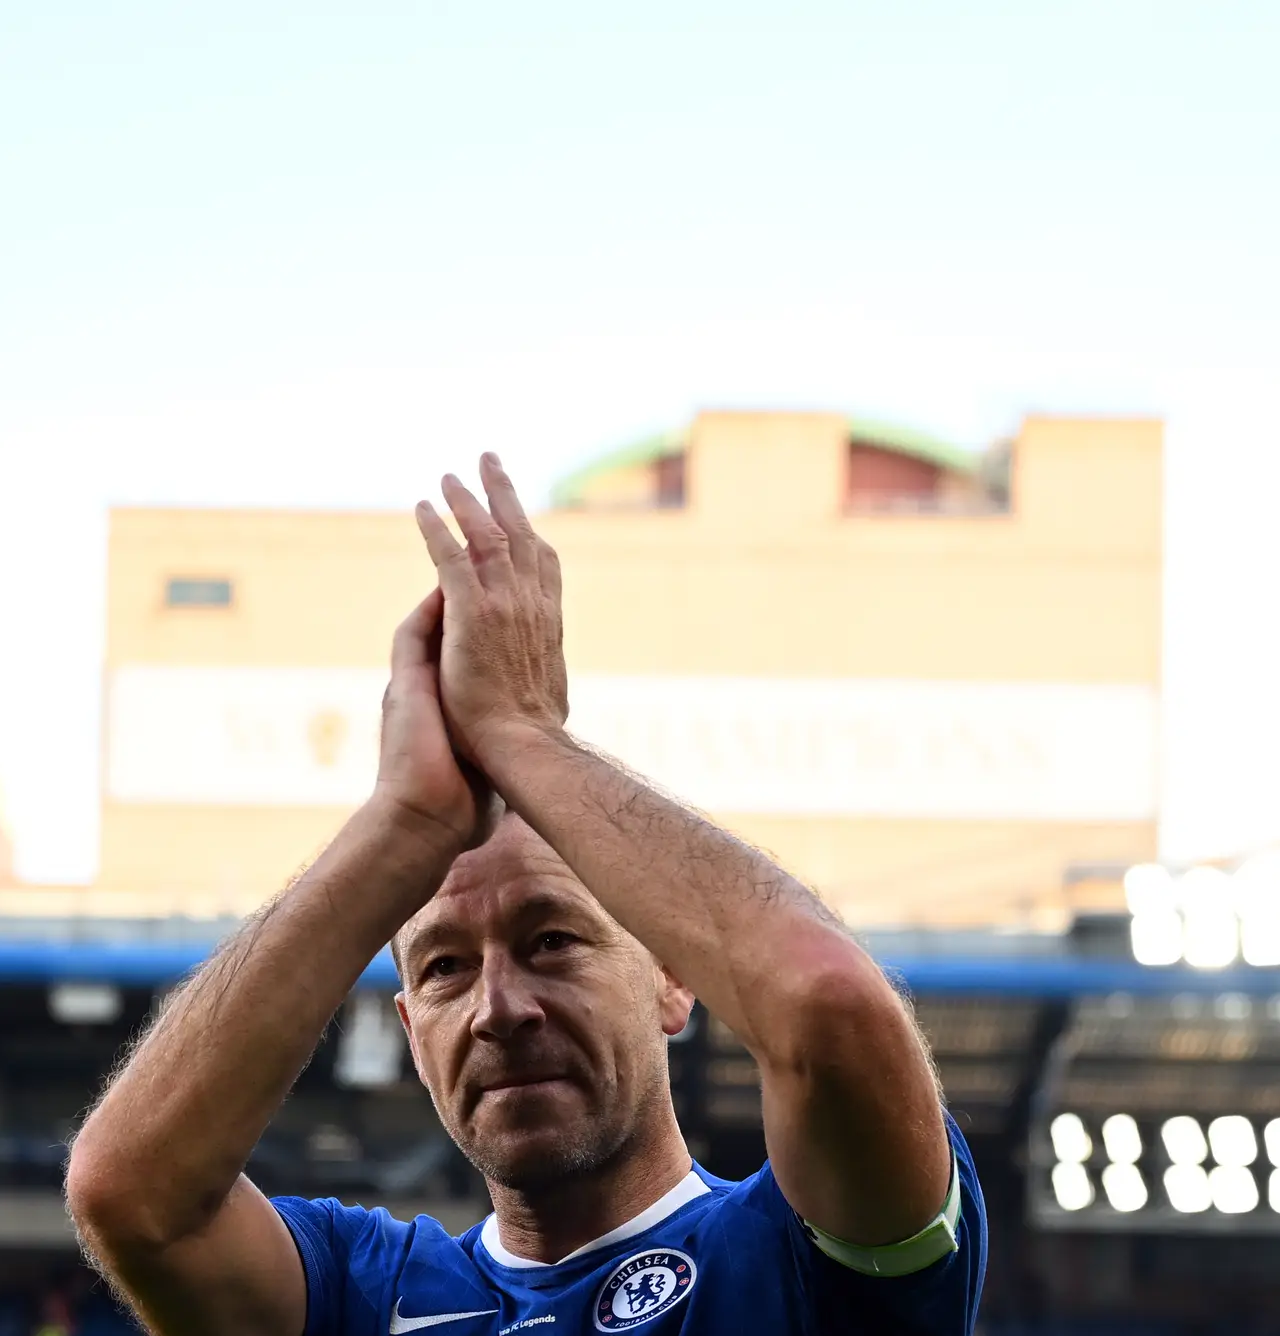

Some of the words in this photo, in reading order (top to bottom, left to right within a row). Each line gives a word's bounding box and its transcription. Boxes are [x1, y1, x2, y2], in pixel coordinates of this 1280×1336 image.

[610, 1255, 669, 1289] CHELSEA
[511, 1322, 519, 1332] FC
[520, 1314, 556, 1328] Legends
[615, 1312, 655, 1327] FOOTBALL
